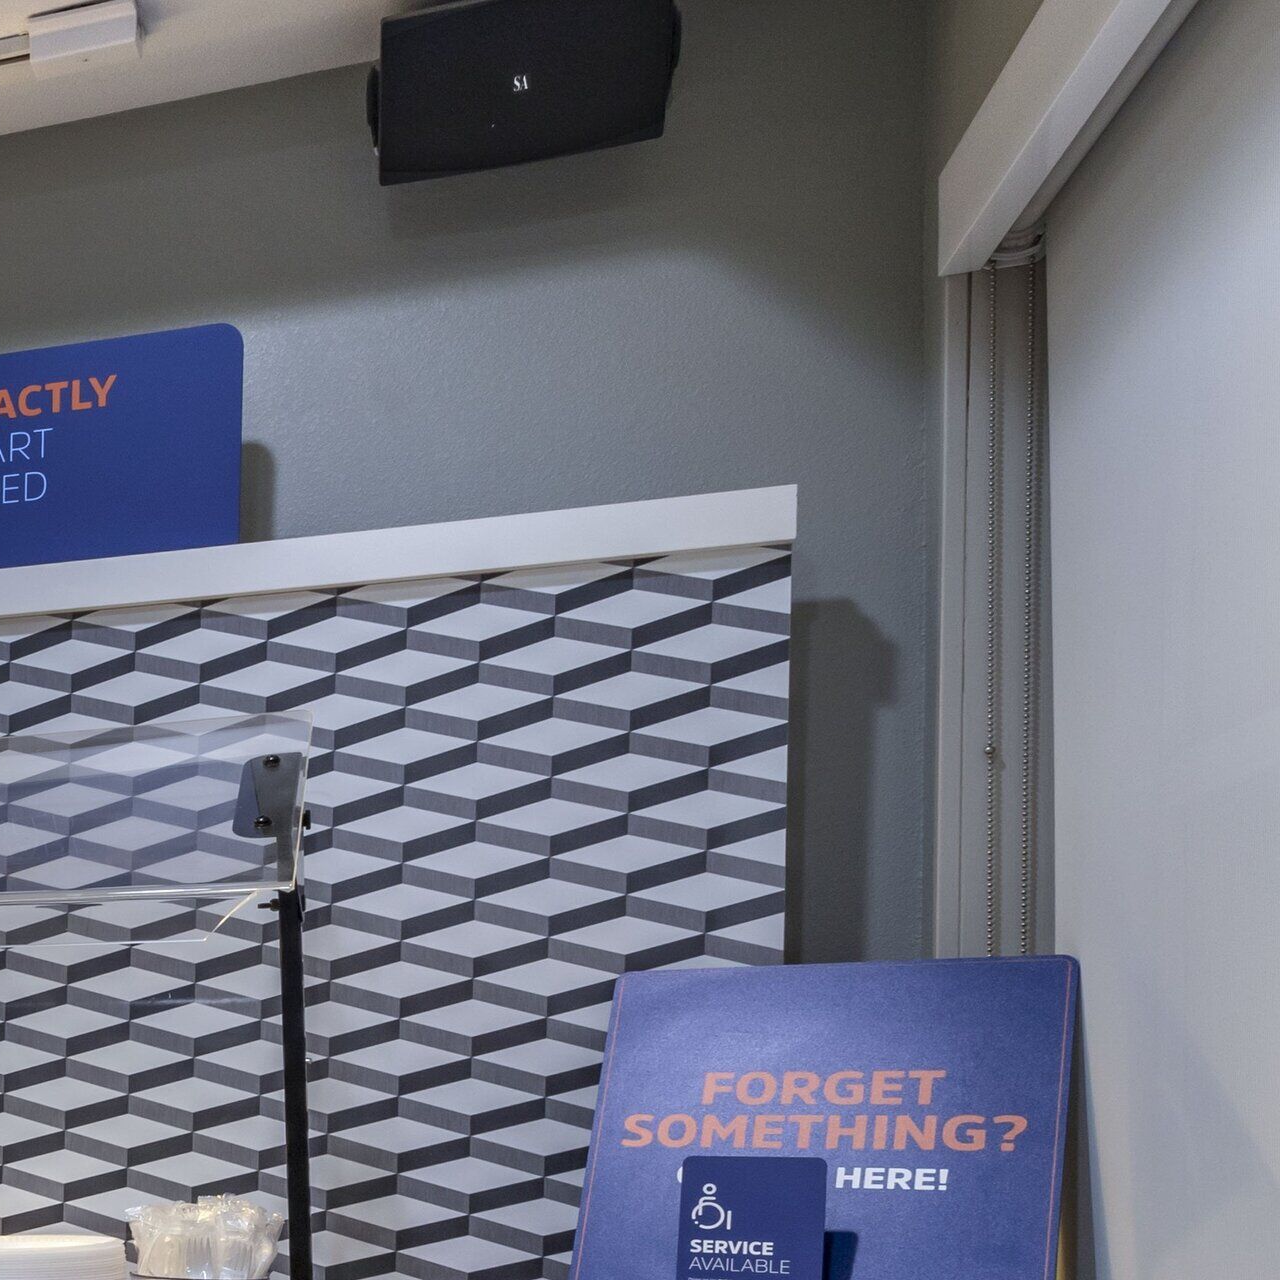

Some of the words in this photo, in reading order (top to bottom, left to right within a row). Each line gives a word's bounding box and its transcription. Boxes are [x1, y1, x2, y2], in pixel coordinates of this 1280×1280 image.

[701, 1070, 947, 1107] FORGET
[620, 1113, 1029, 1153] SOMETHING?
[835, 1166, 949, 1191] HERE!
[690, 1239, 774, 1256] SERVICE
[688, 1256, 791, 1274] AVAILABLE
